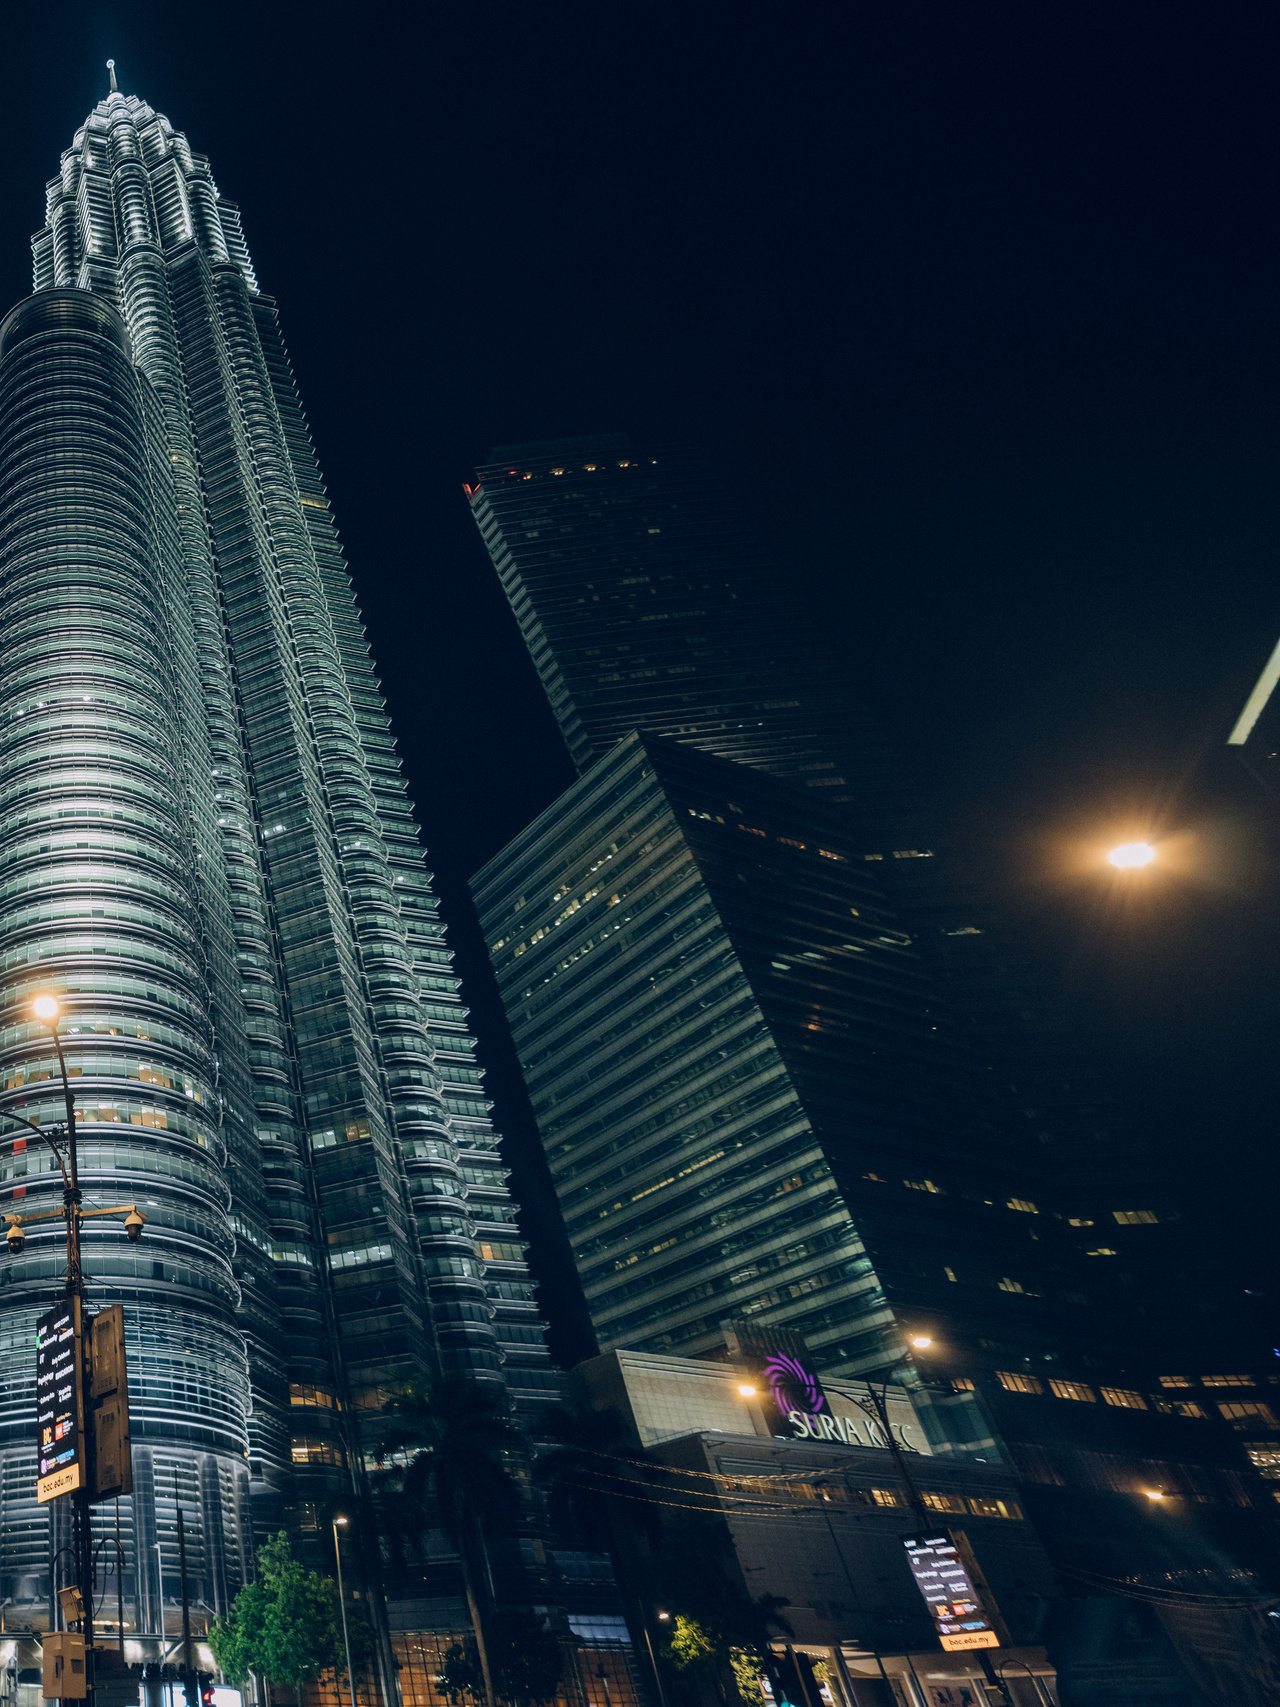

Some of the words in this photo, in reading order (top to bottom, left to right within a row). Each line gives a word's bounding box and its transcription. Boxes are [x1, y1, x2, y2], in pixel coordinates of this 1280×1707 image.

[788, 1410, 864, 1444] SURIA
[863, 1420, 918, 1450] KC
[43, 1474, 73, 1492] bac.edu.my
[948, 1636, 989, 1647] bac.edu.my
